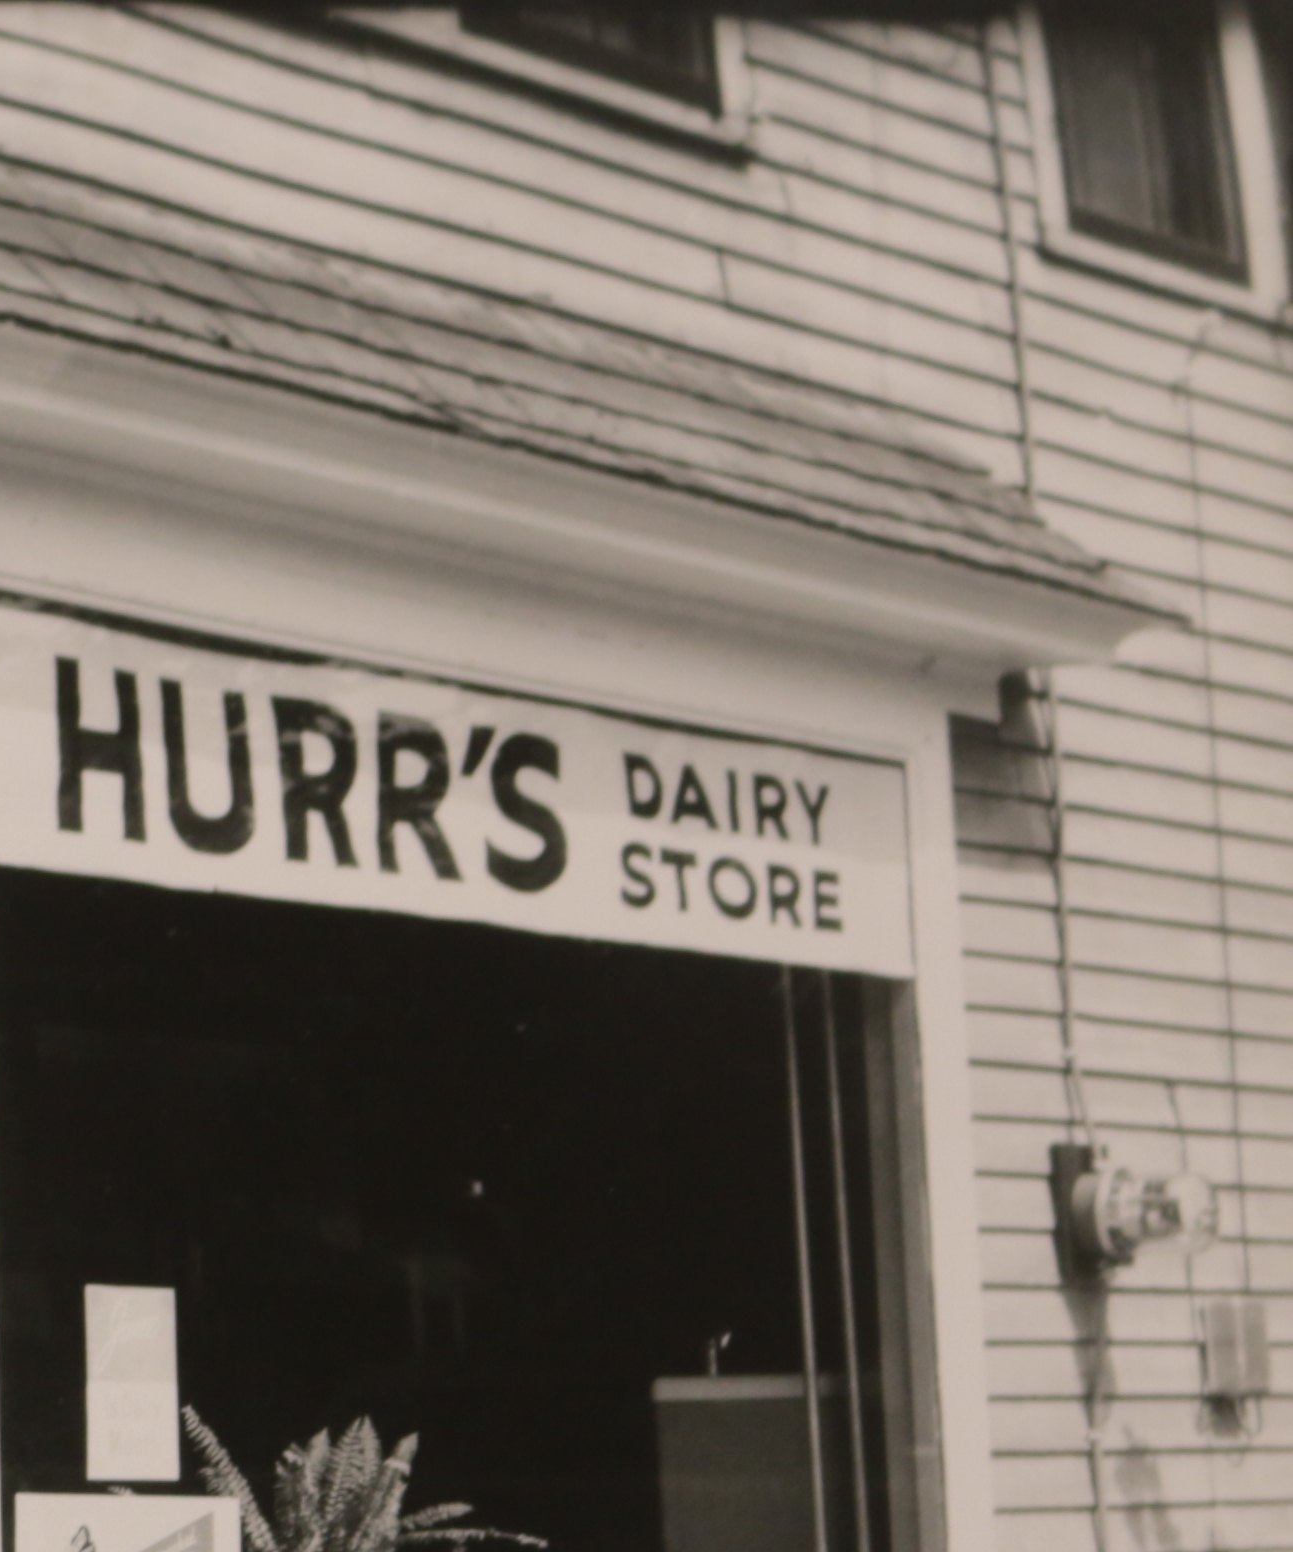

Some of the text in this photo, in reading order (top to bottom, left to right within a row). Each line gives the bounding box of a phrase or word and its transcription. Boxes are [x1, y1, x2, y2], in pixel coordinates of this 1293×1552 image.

[54, 655, 569, 893] HURR'S
[623, 751, 830, 845] DAIRY
[620, 843, 844, 932] STORE
